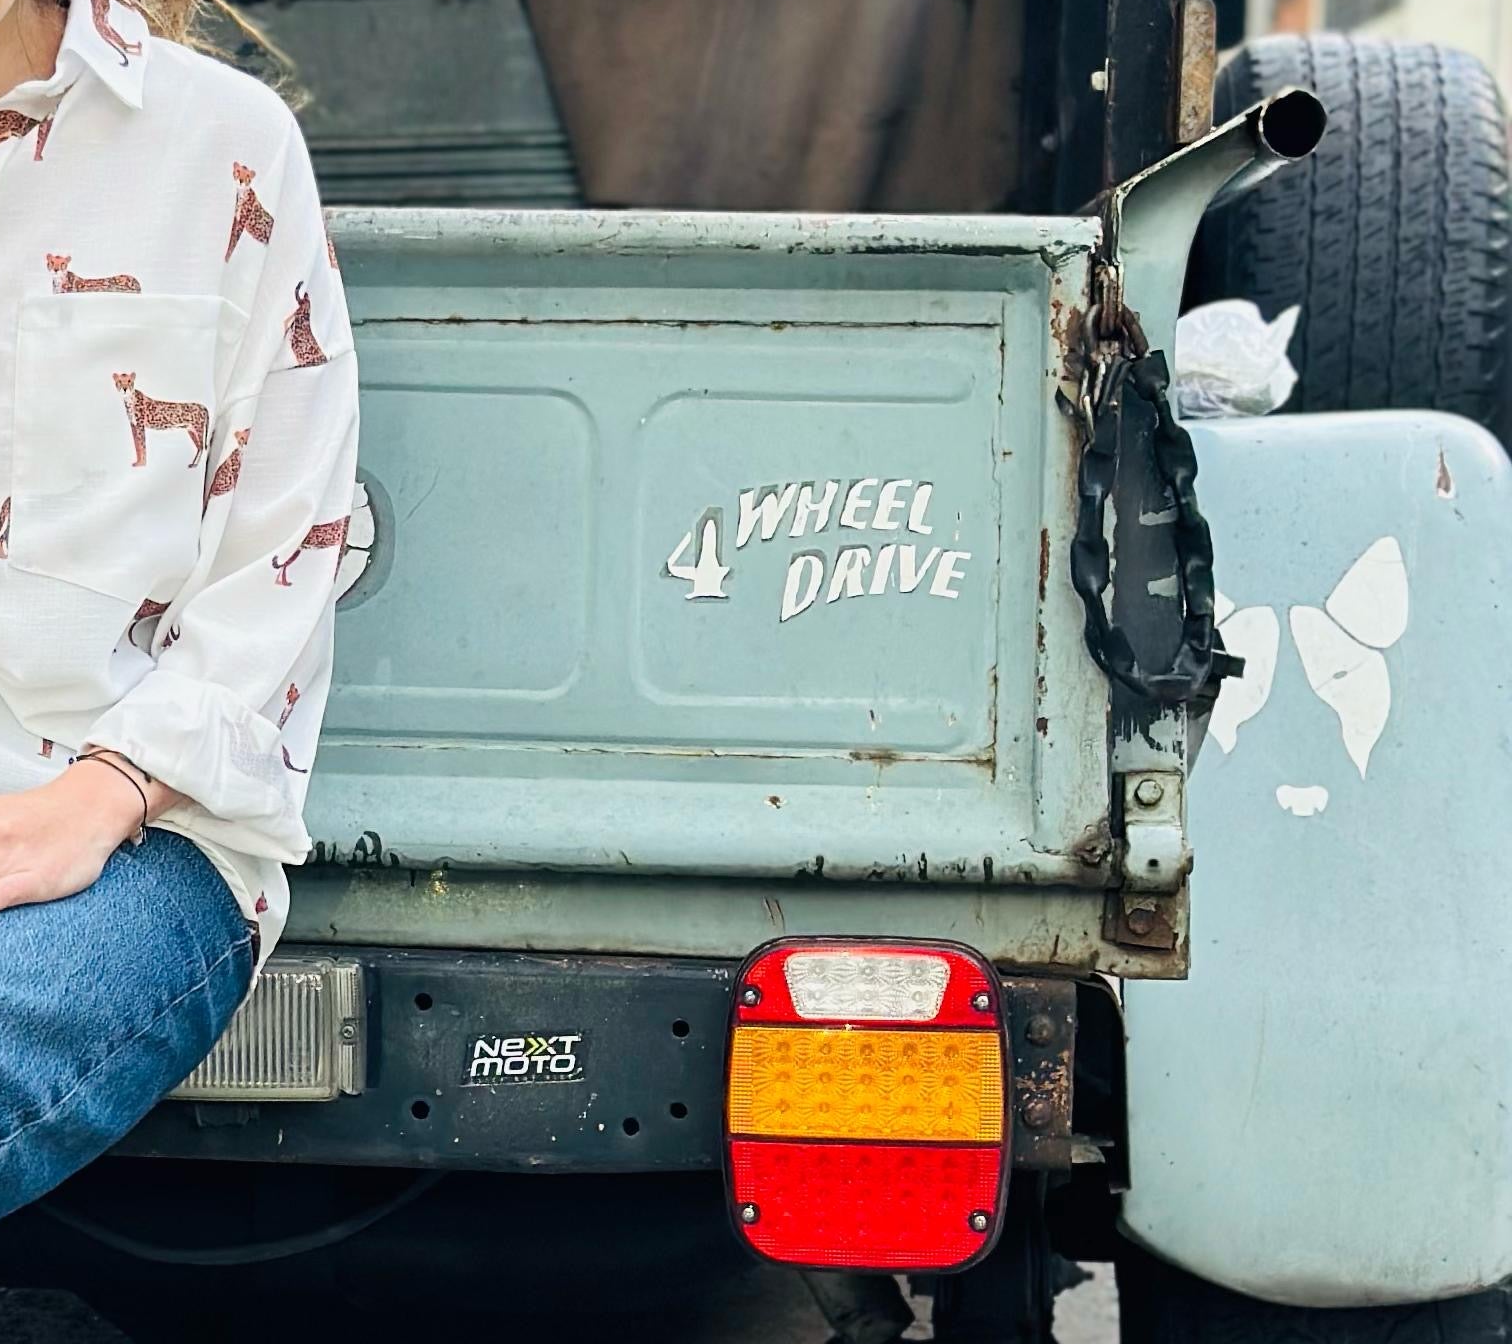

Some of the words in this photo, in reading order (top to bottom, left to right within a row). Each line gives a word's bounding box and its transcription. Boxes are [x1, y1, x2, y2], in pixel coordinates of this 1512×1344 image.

[666, 518, 731, 599] 4
[735, 477, 934, 547] WHEEL
[780, 543, 972, 622] DRIVE
